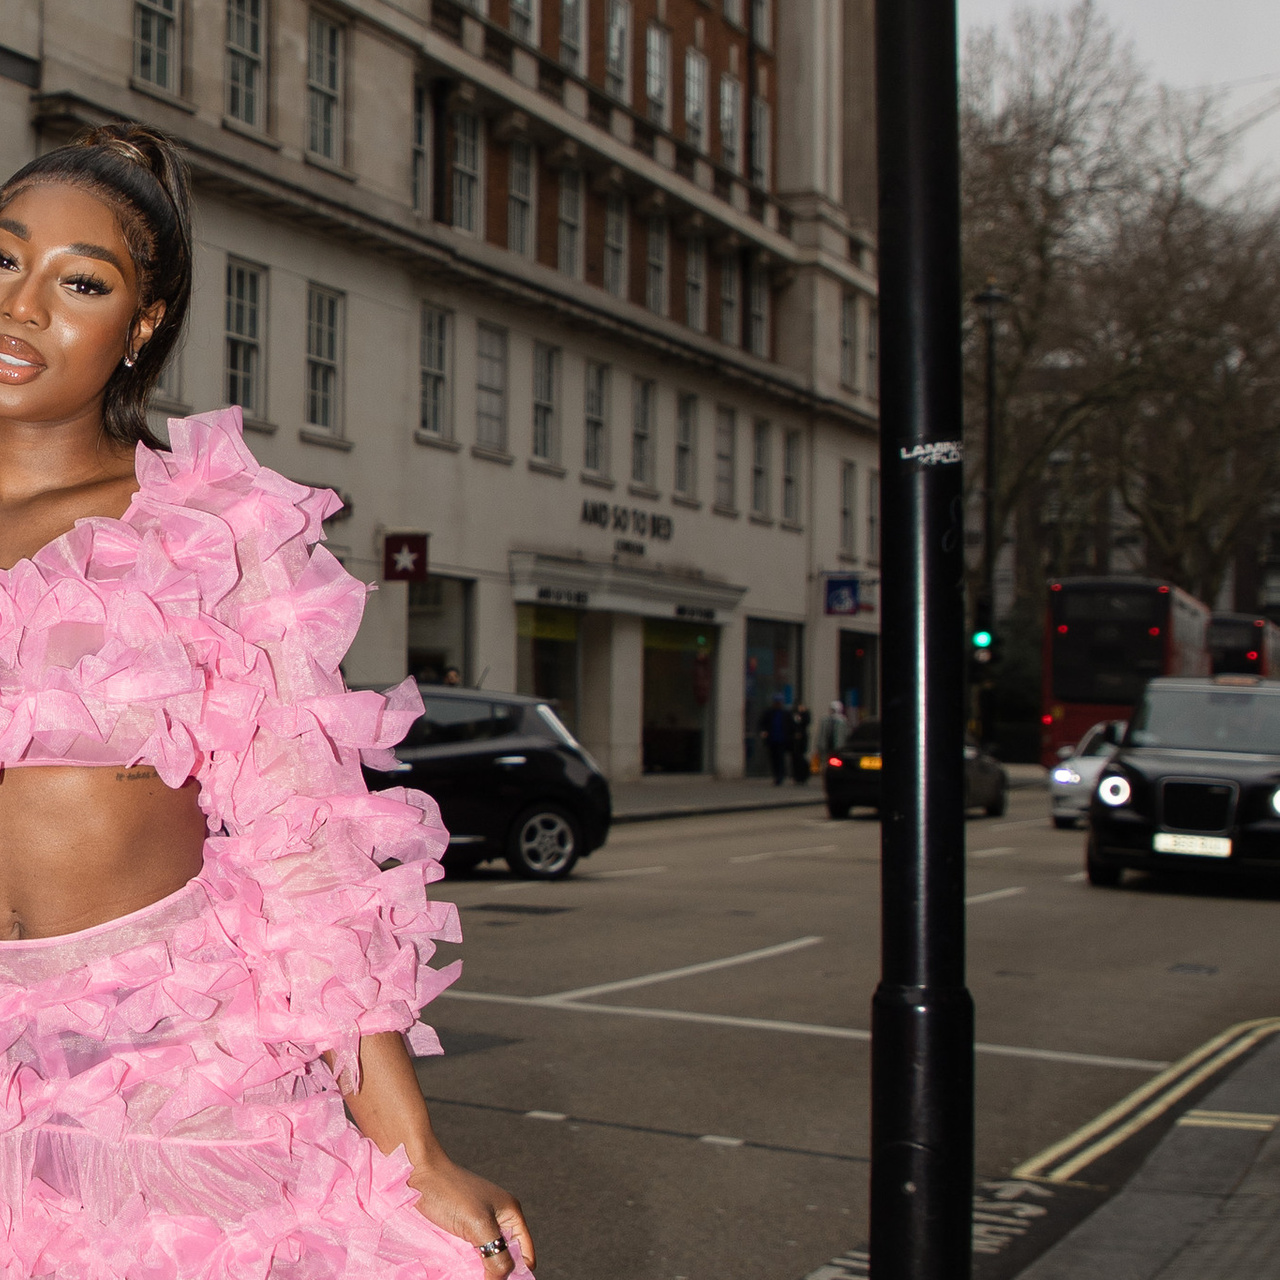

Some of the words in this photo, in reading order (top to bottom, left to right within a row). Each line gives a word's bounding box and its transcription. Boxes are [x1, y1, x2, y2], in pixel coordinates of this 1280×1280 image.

[581, 499, 609, 529] AND
[612, 505, 629, 532] SO
[631, 508, 648, 536] TO
[650, 513, 674, 541] BED
